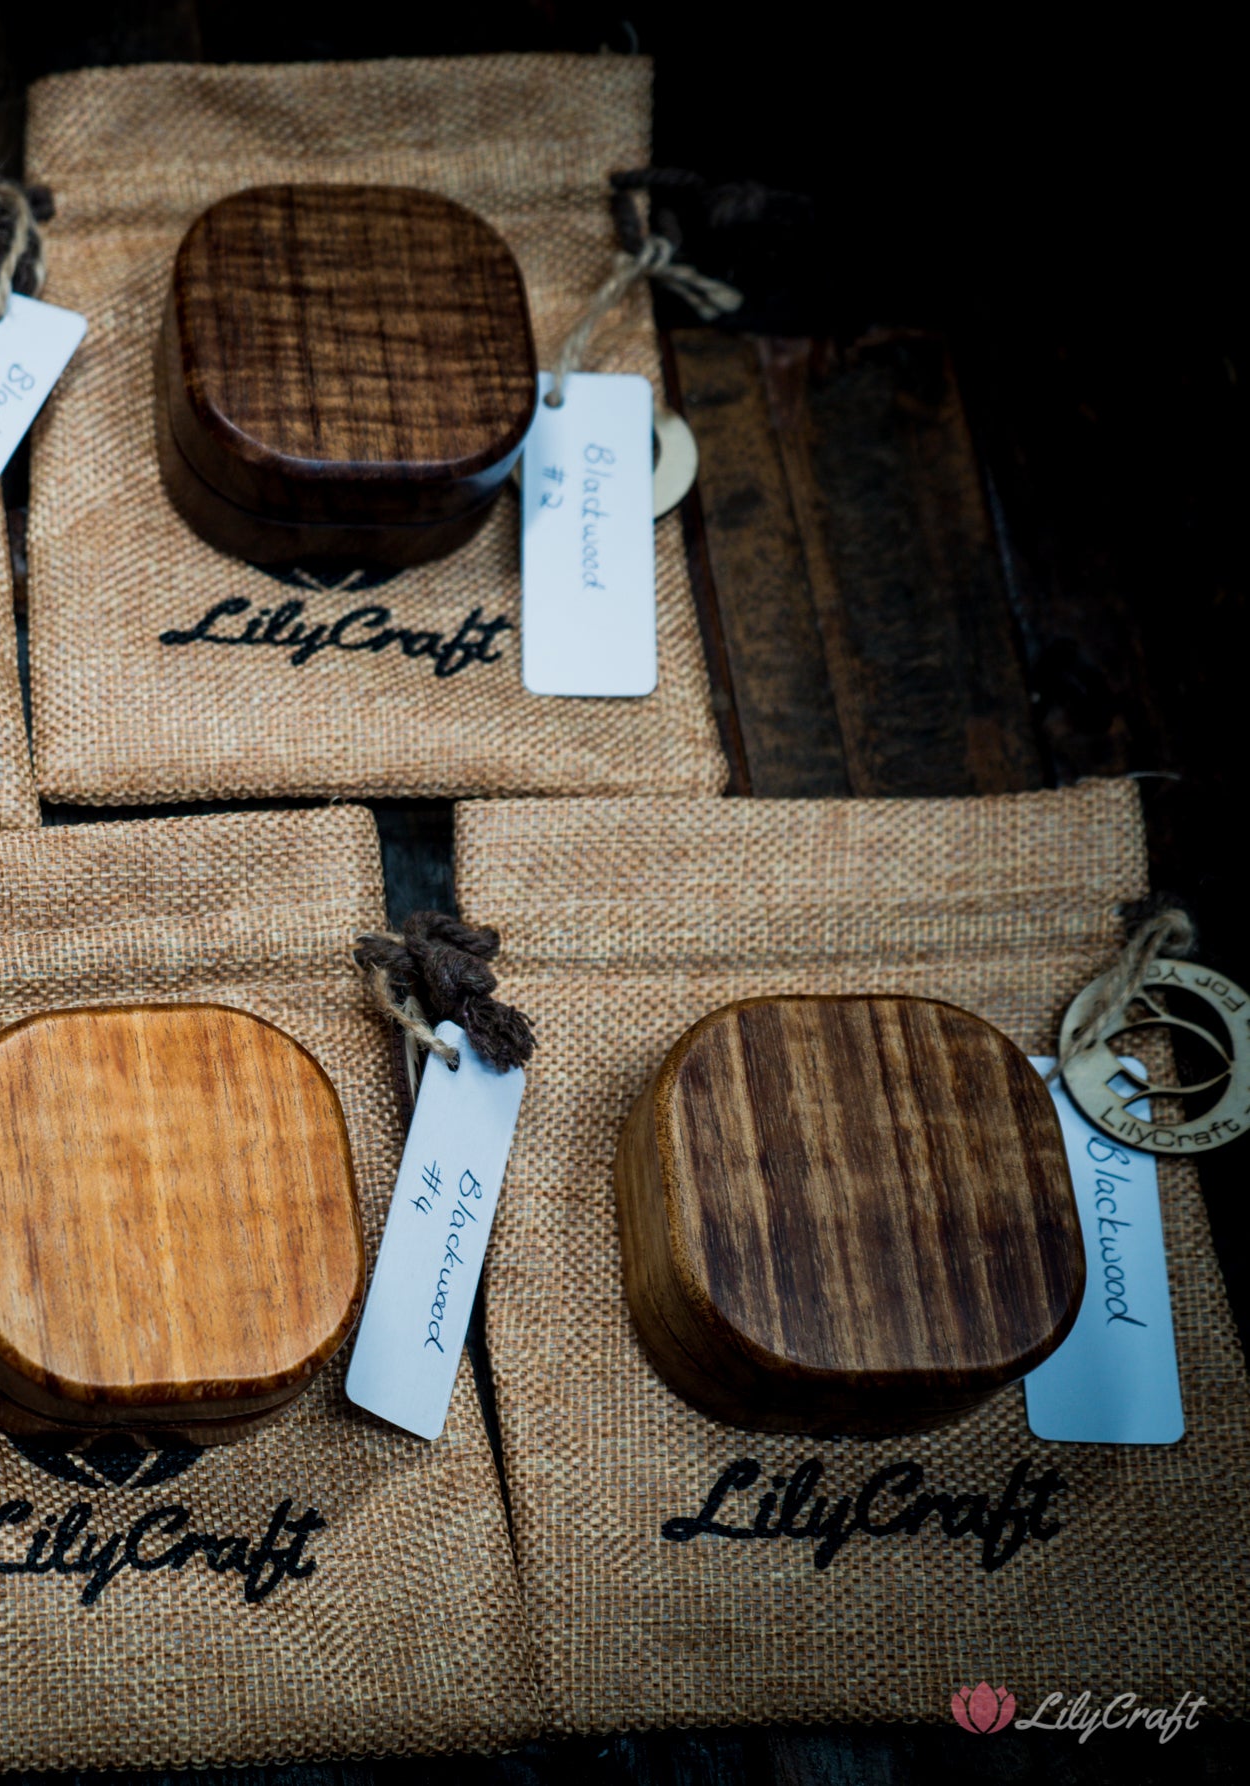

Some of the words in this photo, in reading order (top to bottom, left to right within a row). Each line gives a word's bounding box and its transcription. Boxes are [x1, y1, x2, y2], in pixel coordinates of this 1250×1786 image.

[582, 443, 615, 590] Blackwood
[159, 597, 513, 677] LilyCraft
[1146, 965, 1183, 984] Yo
[1100, 1106, 1241, 1148] LilyCraft
[410, 1160, 443, 1216] #4
[1086, 1134, 1148, 1328] Blackwood
[424, 1169, 482, 1354] Blackwood
[661, 1457, 1069, 1572] LilyCraft
